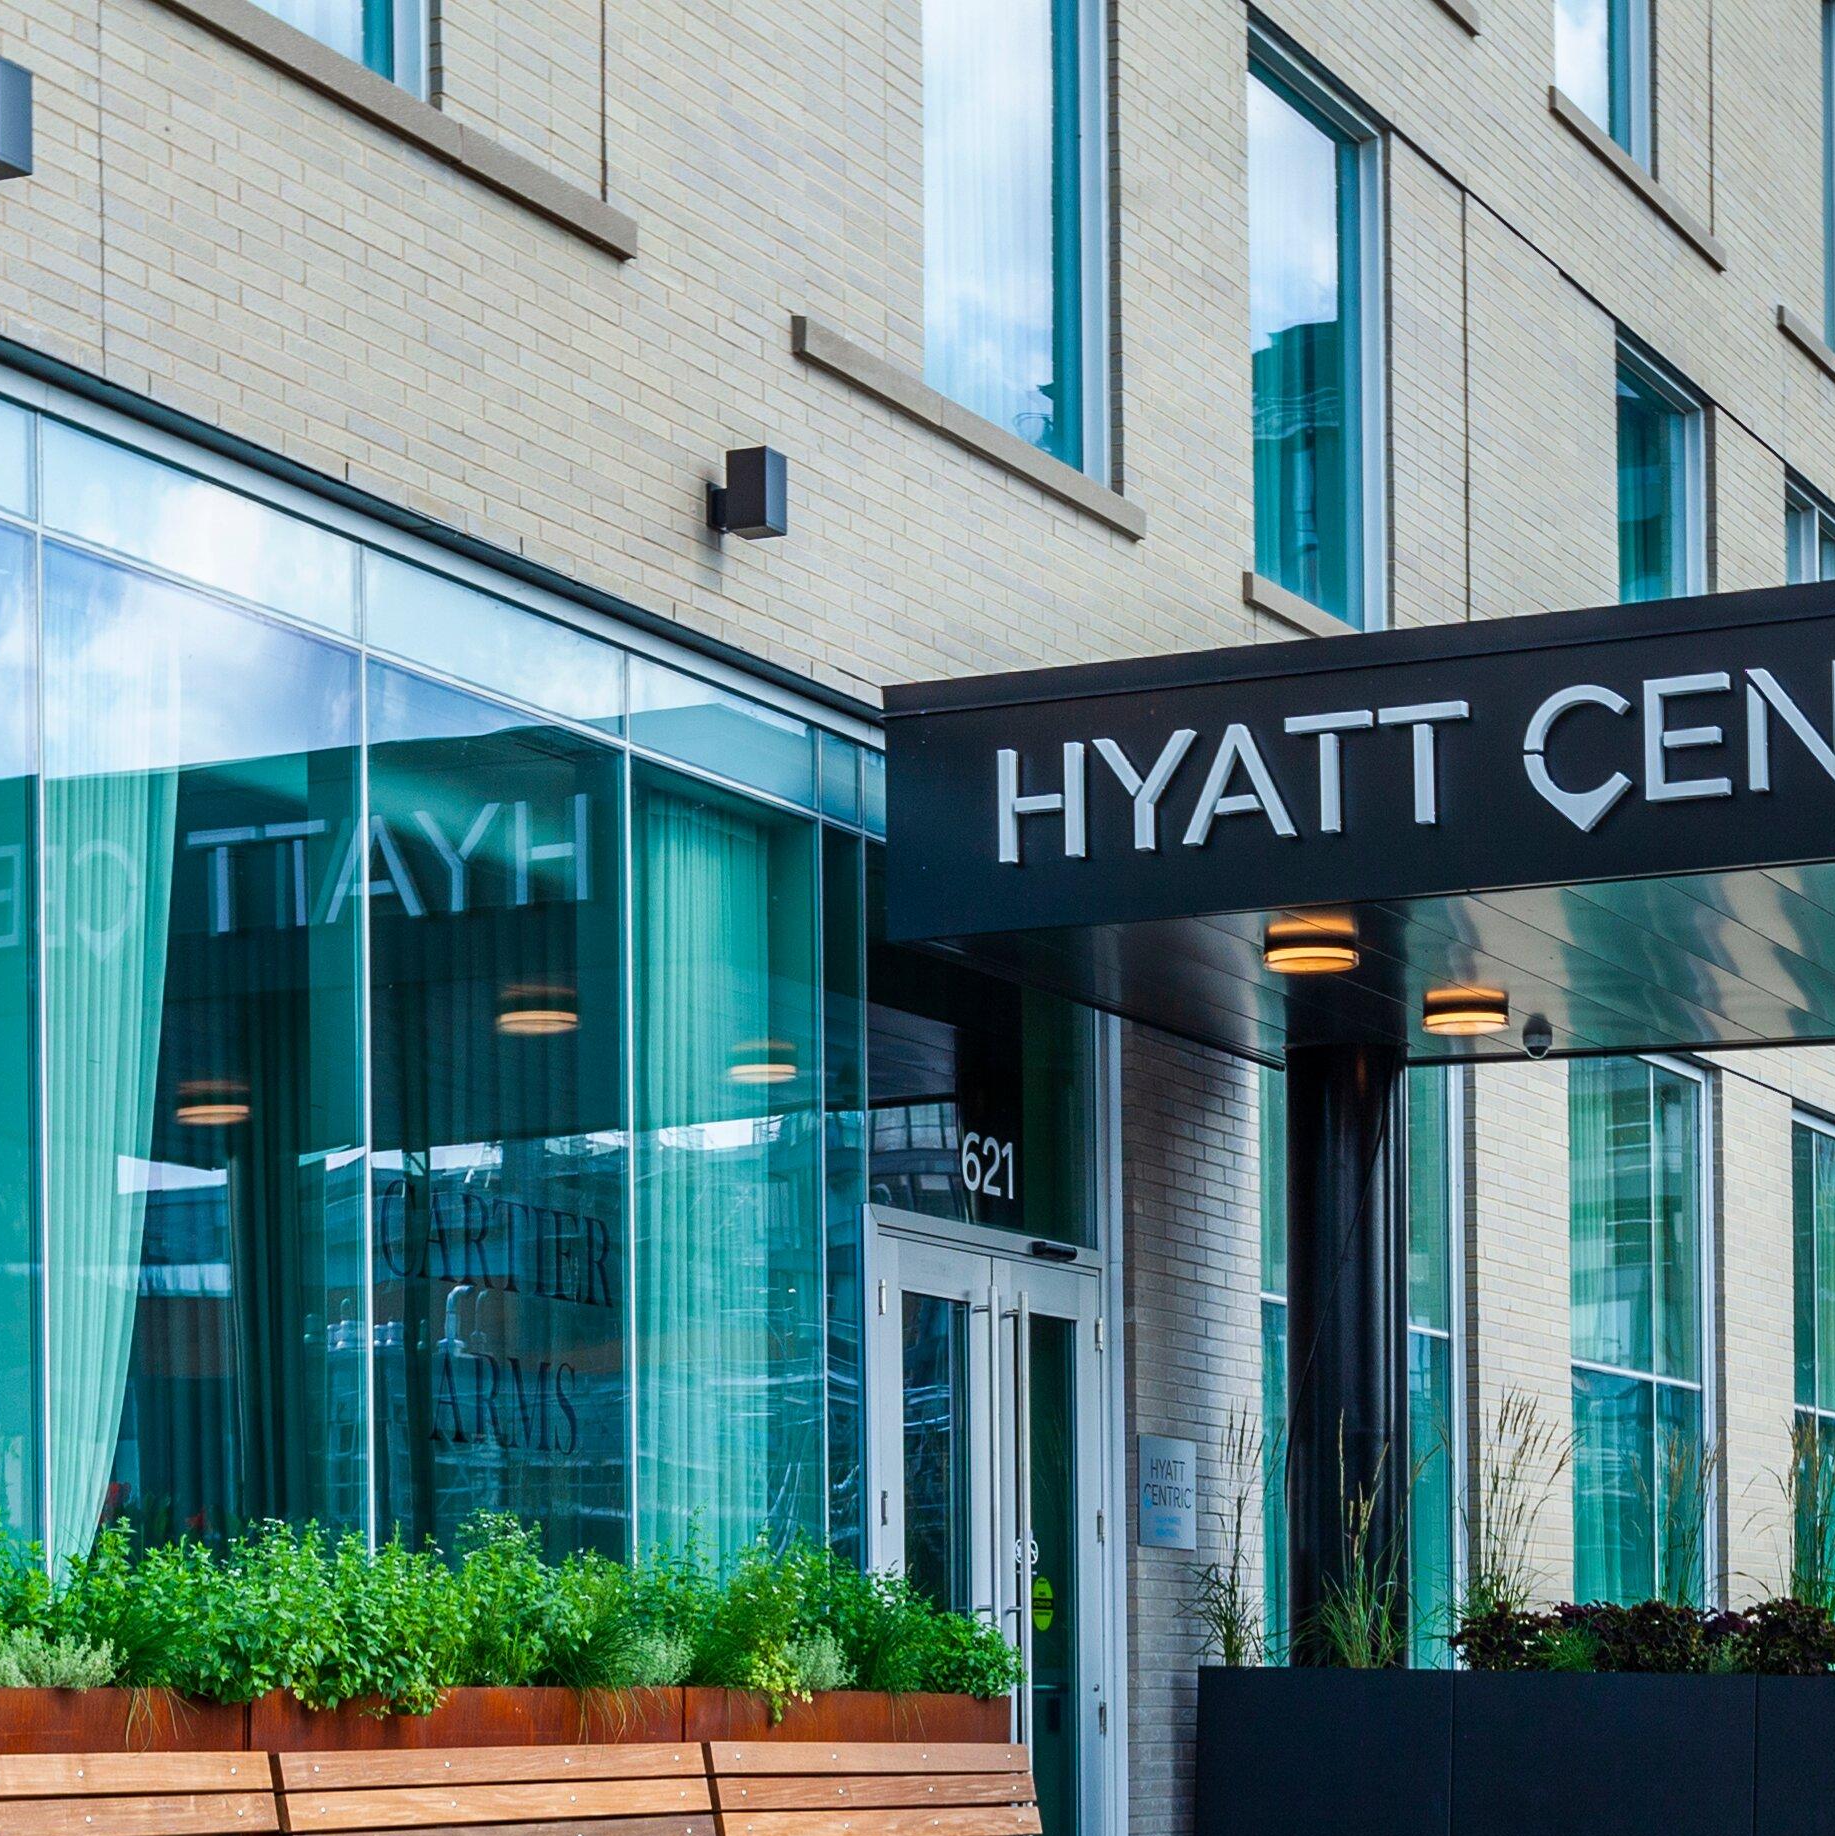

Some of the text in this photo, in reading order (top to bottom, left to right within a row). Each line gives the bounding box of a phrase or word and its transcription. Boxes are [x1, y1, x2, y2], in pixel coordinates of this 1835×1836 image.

[996, 700, 1470, 864] HYATT
[962, 1131, 1014, 1200] 621
[380, 1178, 614, 1308] CARTIER
[428, 1350, 577, 1456] ARMS
[1144, 1483, 1192, 1509] CENTRIC
[1150, 1458, 1185, 1482] HYATT
